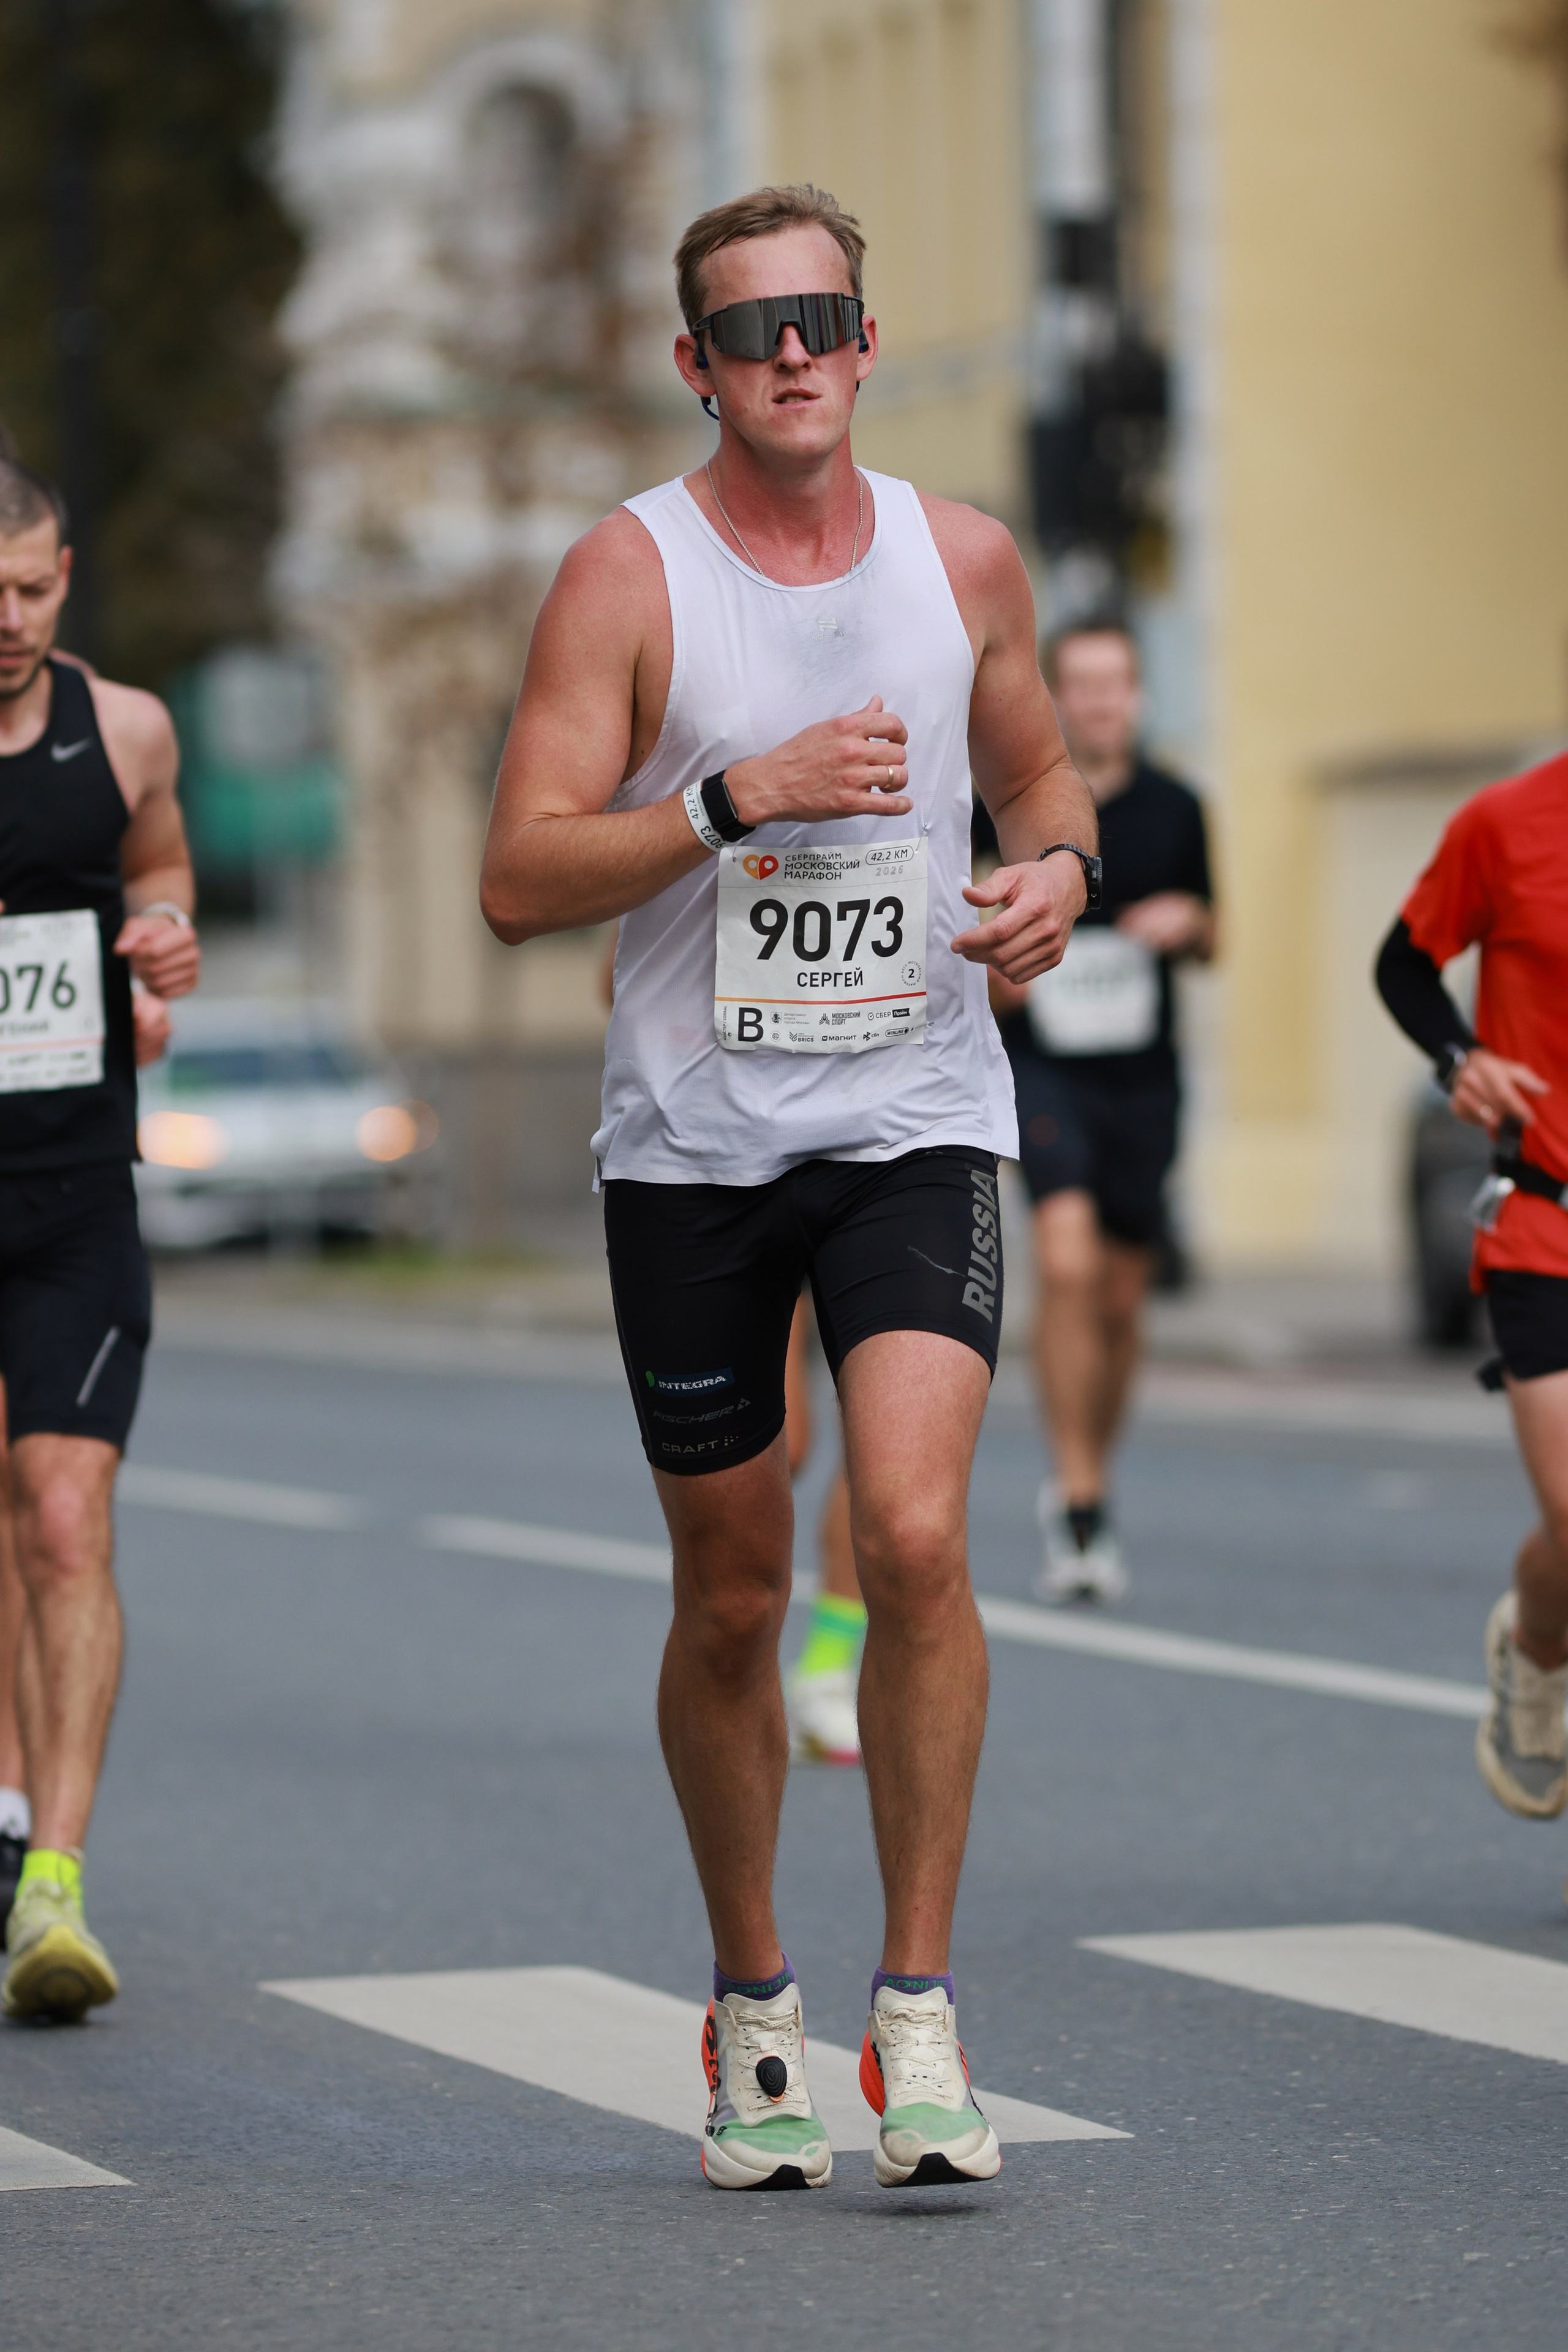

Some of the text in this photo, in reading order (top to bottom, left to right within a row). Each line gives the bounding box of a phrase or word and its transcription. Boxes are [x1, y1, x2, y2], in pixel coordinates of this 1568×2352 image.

[687, 799, 699, 820] 42,2
[700, 826, 726, 849] 9073
[785, 852, 842, 862] СБЕРПРАЙМ
[870, 851, 891, 862] 42,2
[785, 859, 860, 871] МОСКОВСКИЙ
[875, 865, 904, 876] 2026
[784, 871, 842, 880] МАРАФОН
[749, 895, 904, 962] 9073
[796, 967, 864, 988] СЕРГЕЙ
[908, 968, 914, 978] 2
[962, 1169, 998, 1324] RUSSIA
[658, 1376, 727, 1390] INTEGRA
[653, 1405, 734, 1423] FISCHER
[662, 1440, 718, 1453] CRAFT
